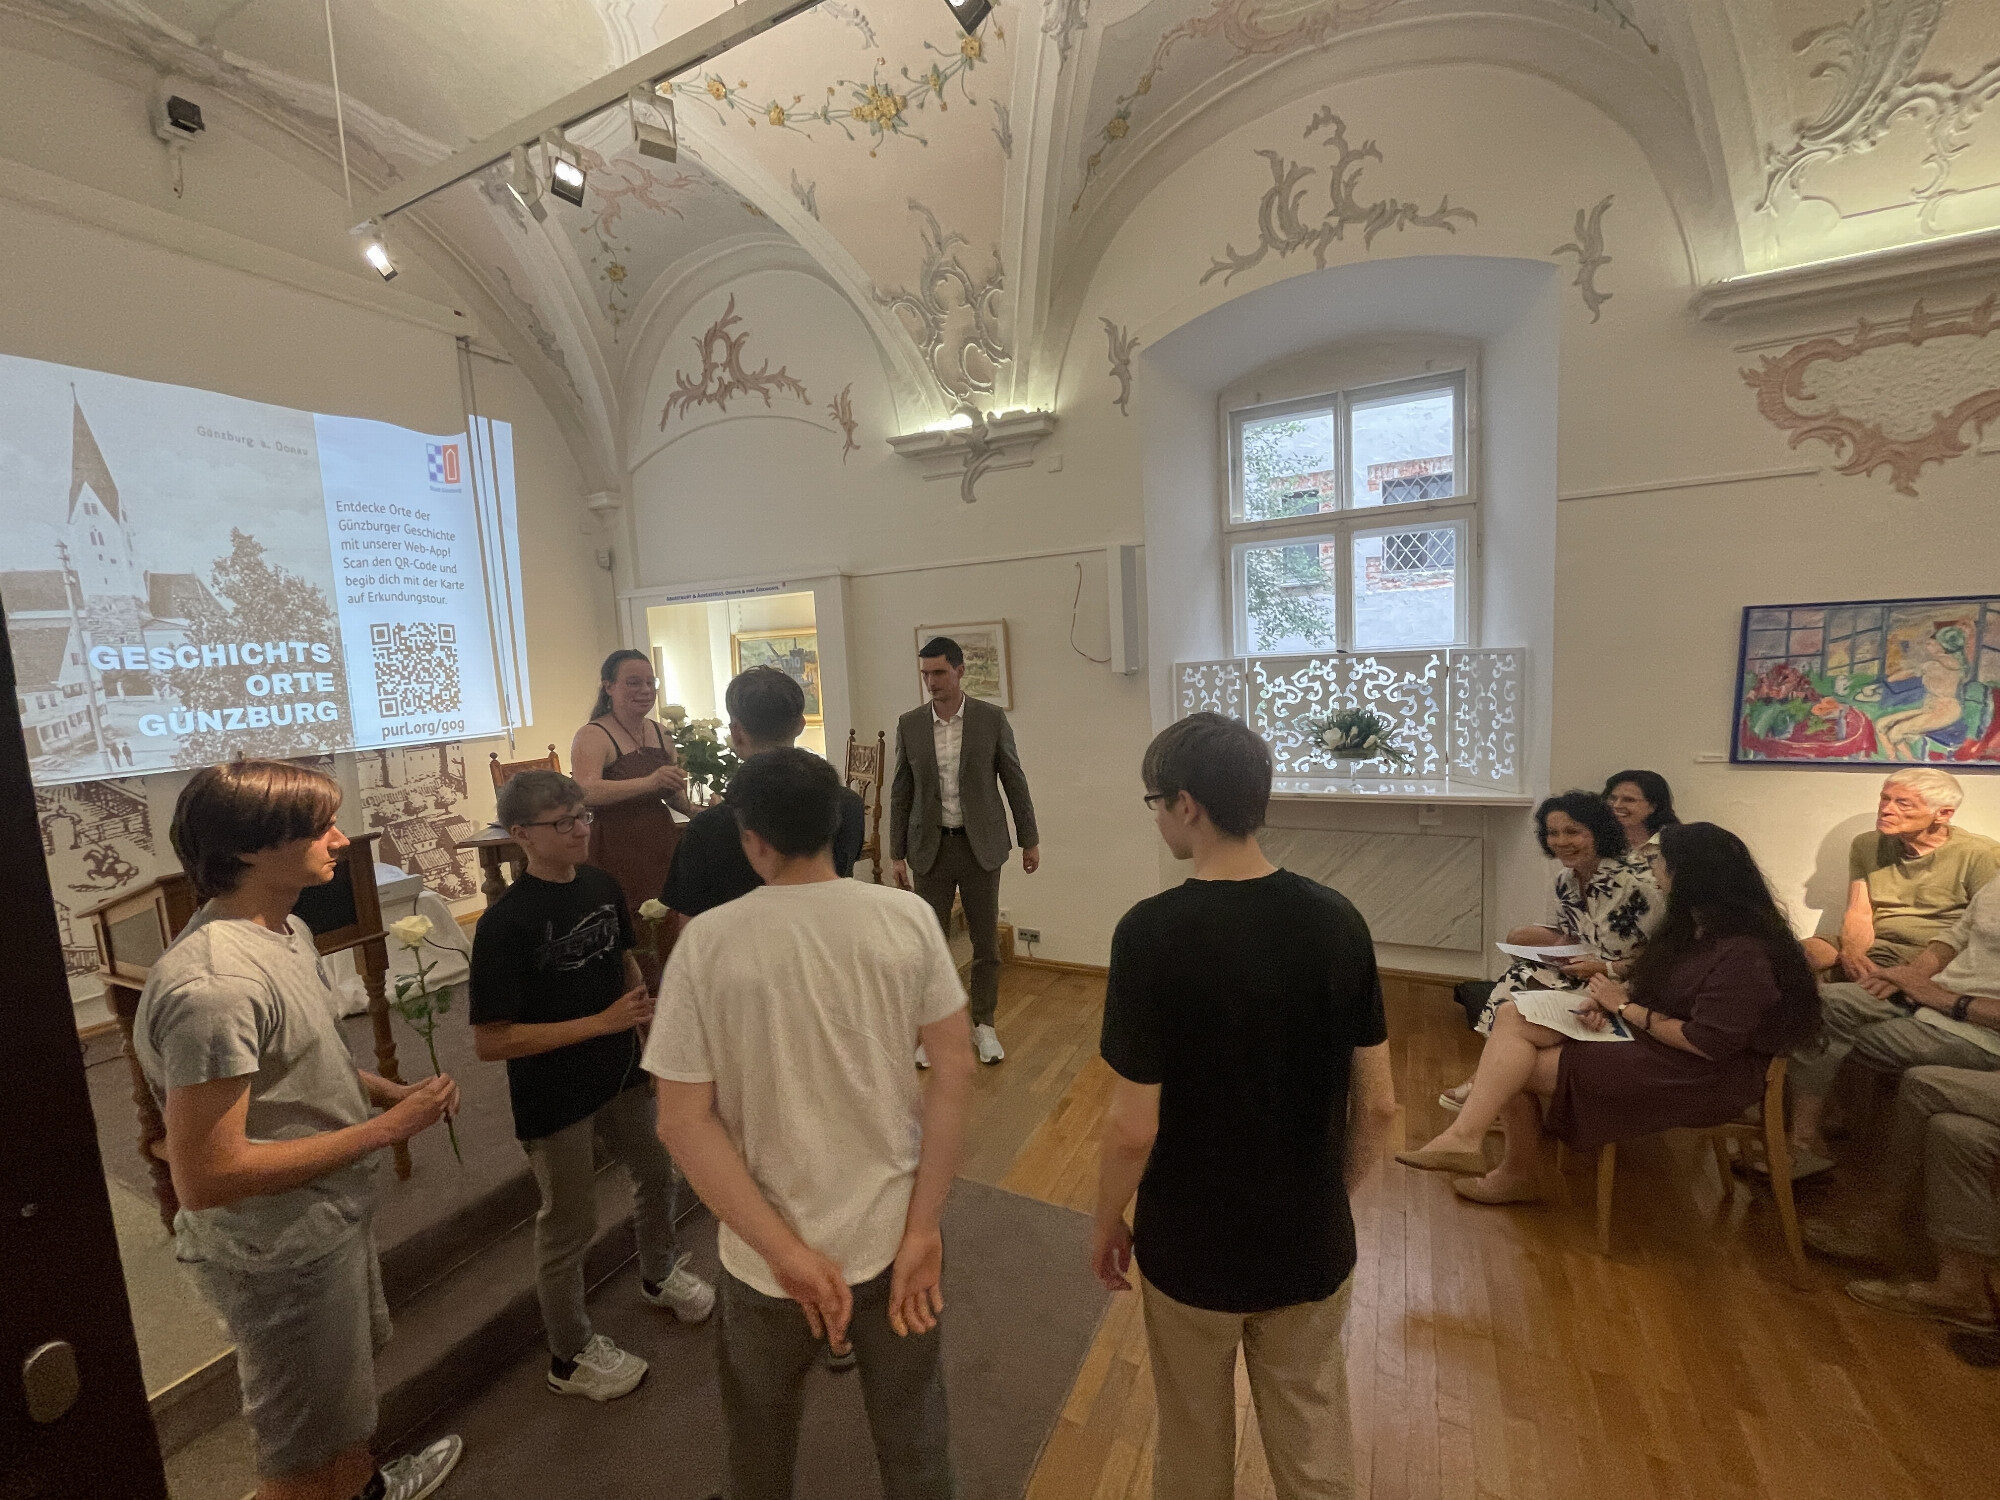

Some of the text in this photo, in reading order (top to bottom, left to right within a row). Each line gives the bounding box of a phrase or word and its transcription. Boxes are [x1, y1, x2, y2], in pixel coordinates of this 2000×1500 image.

[275, 441, 308, 456] Donau
[336, 501, 430, 521] Entdecke Orte der
[338, 519, 456, 541] Günzburger Geschichte
[341, 538, 451, 559] mit unserer Web-App!
[343, 556, 457, 574] Scan den QR-Code und
[345, 574, 465, 590] begib dich mit der Karte
[347, 590, 448, 605] auf Erkundungstour.
[88, 641, 332, 670] GESCHICHTS
[245, 671, 335, 697] ORTE
[138, 701, 339, 737] GÜNZBURG
[381, 718, 465, 741] purl.org/gog
